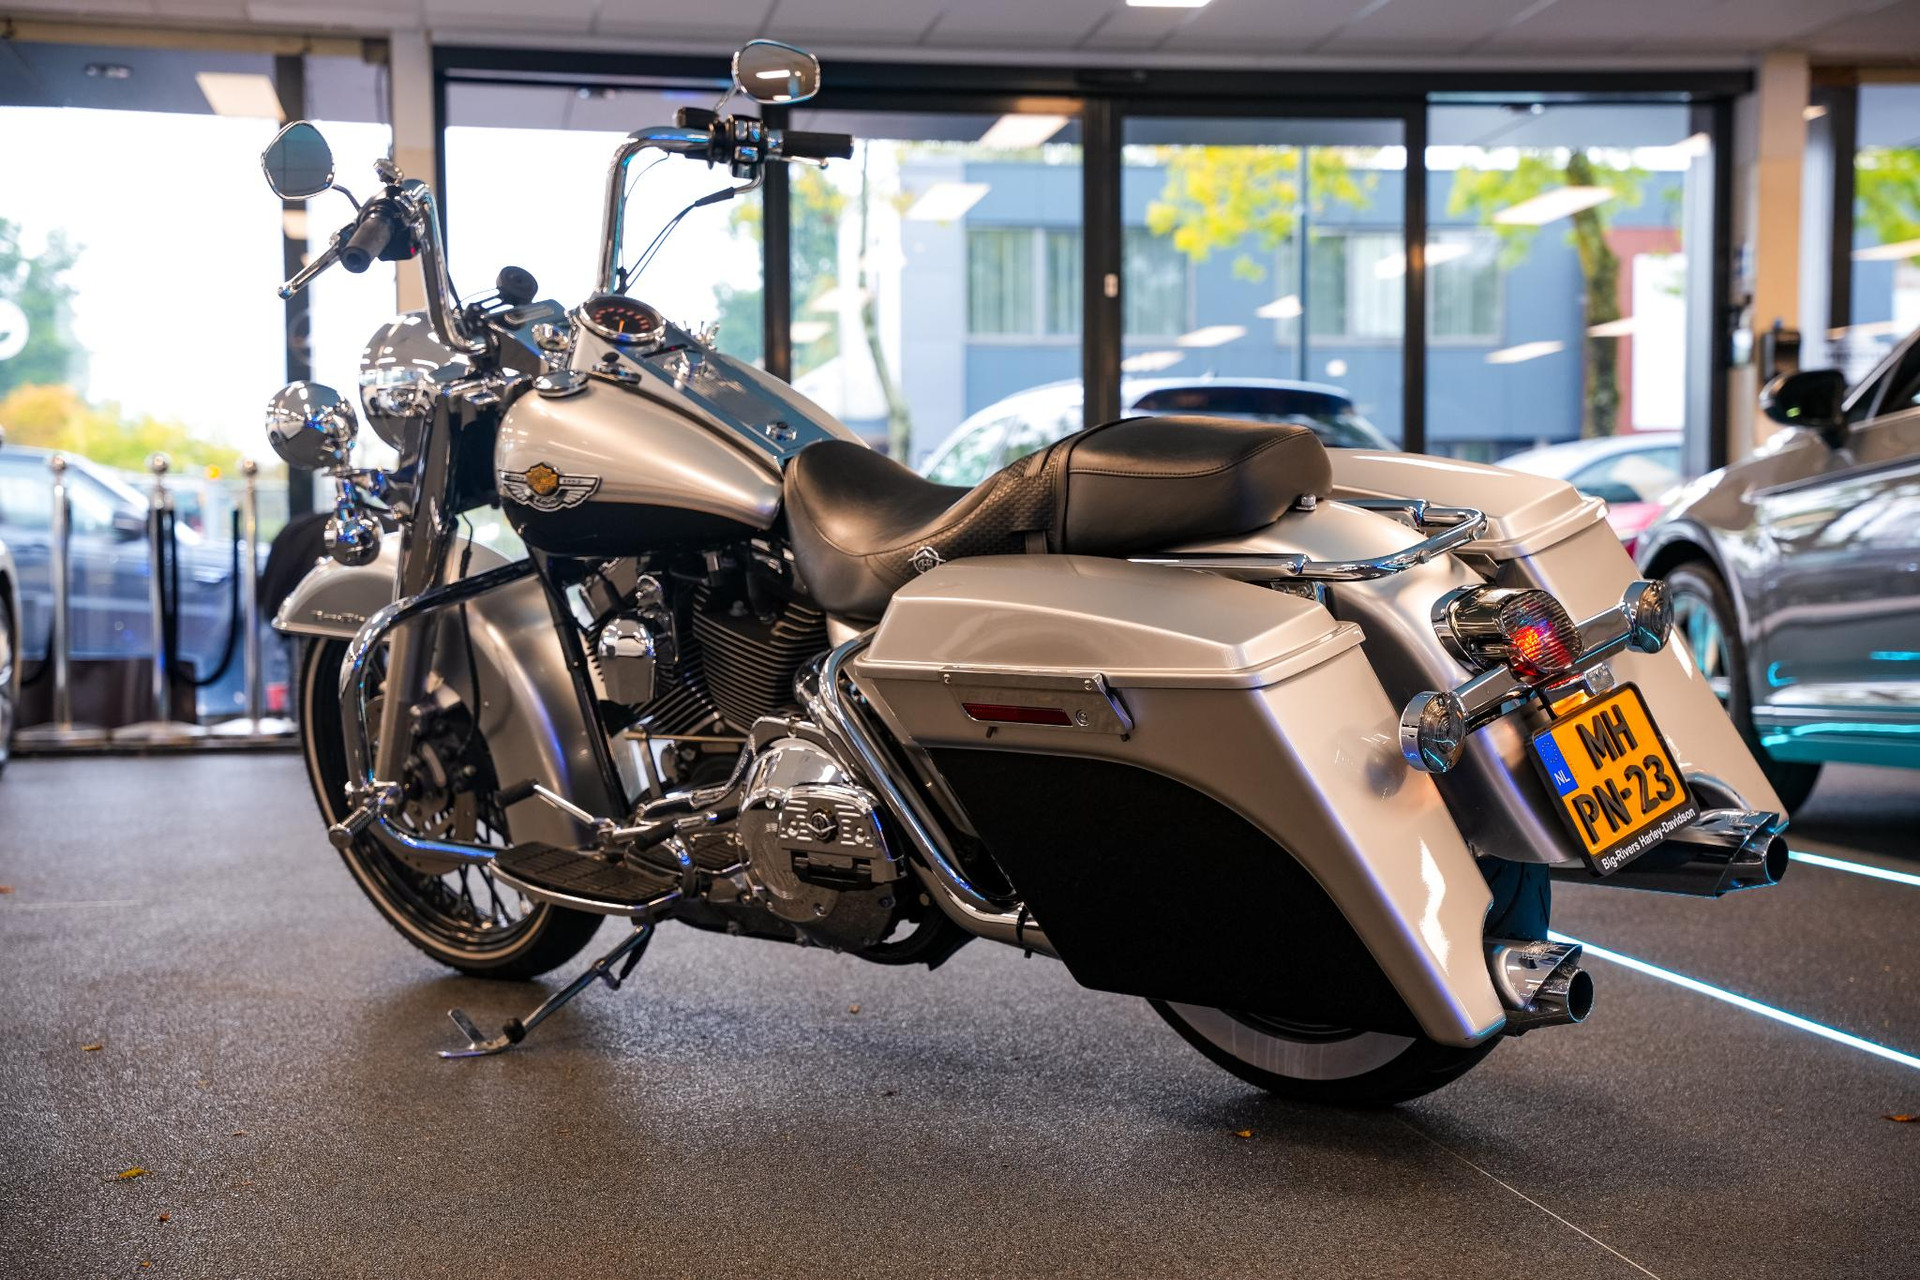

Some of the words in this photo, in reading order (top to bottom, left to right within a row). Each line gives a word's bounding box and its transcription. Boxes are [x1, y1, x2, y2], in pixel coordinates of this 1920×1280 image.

[1576, 704, 1638, 770] MH
[1554, 770, 1571, 786] NL
[1572, 755, 1676, 845] PN-23
[1601, 841, 1640, 870] Big-Rivers
[1639, 808, 1695, 847] Harley-Davidson
